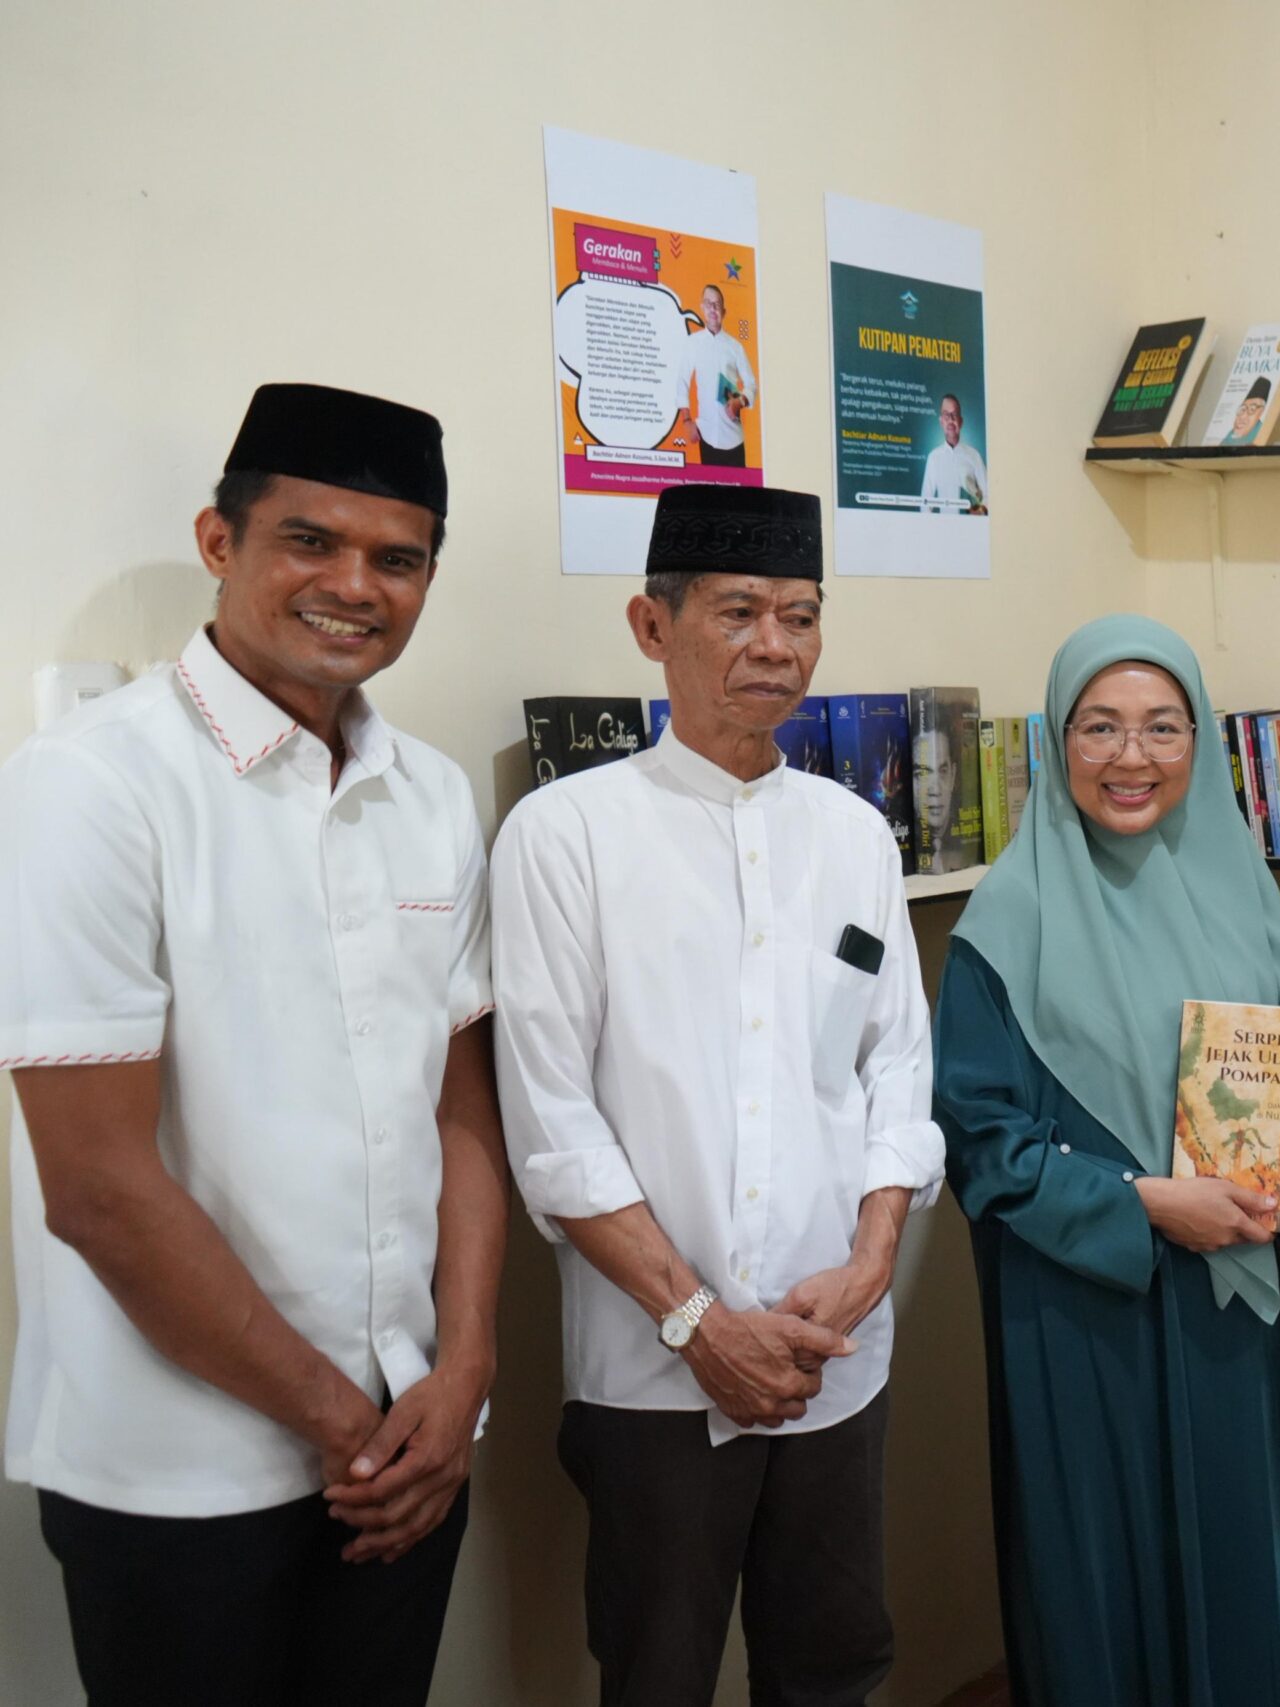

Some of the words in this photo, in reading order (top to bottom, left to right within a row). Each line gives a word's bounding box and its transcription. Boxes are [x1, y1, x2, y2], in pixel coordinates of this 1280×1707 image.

[584, 238, 642, 262] Gerakan
[859, 326, 906, 356] KUTIPAN
[910, 335, 961, 363] PEMATERI
[1240, 345, 1270, 358] BUYA
[1233, 359, 1280, 374] HAMKA
[570, 712, 594, 751] La
[844, 760, 851, 771] 3
[1206, 1046, 1252, 1064] JEJAK
